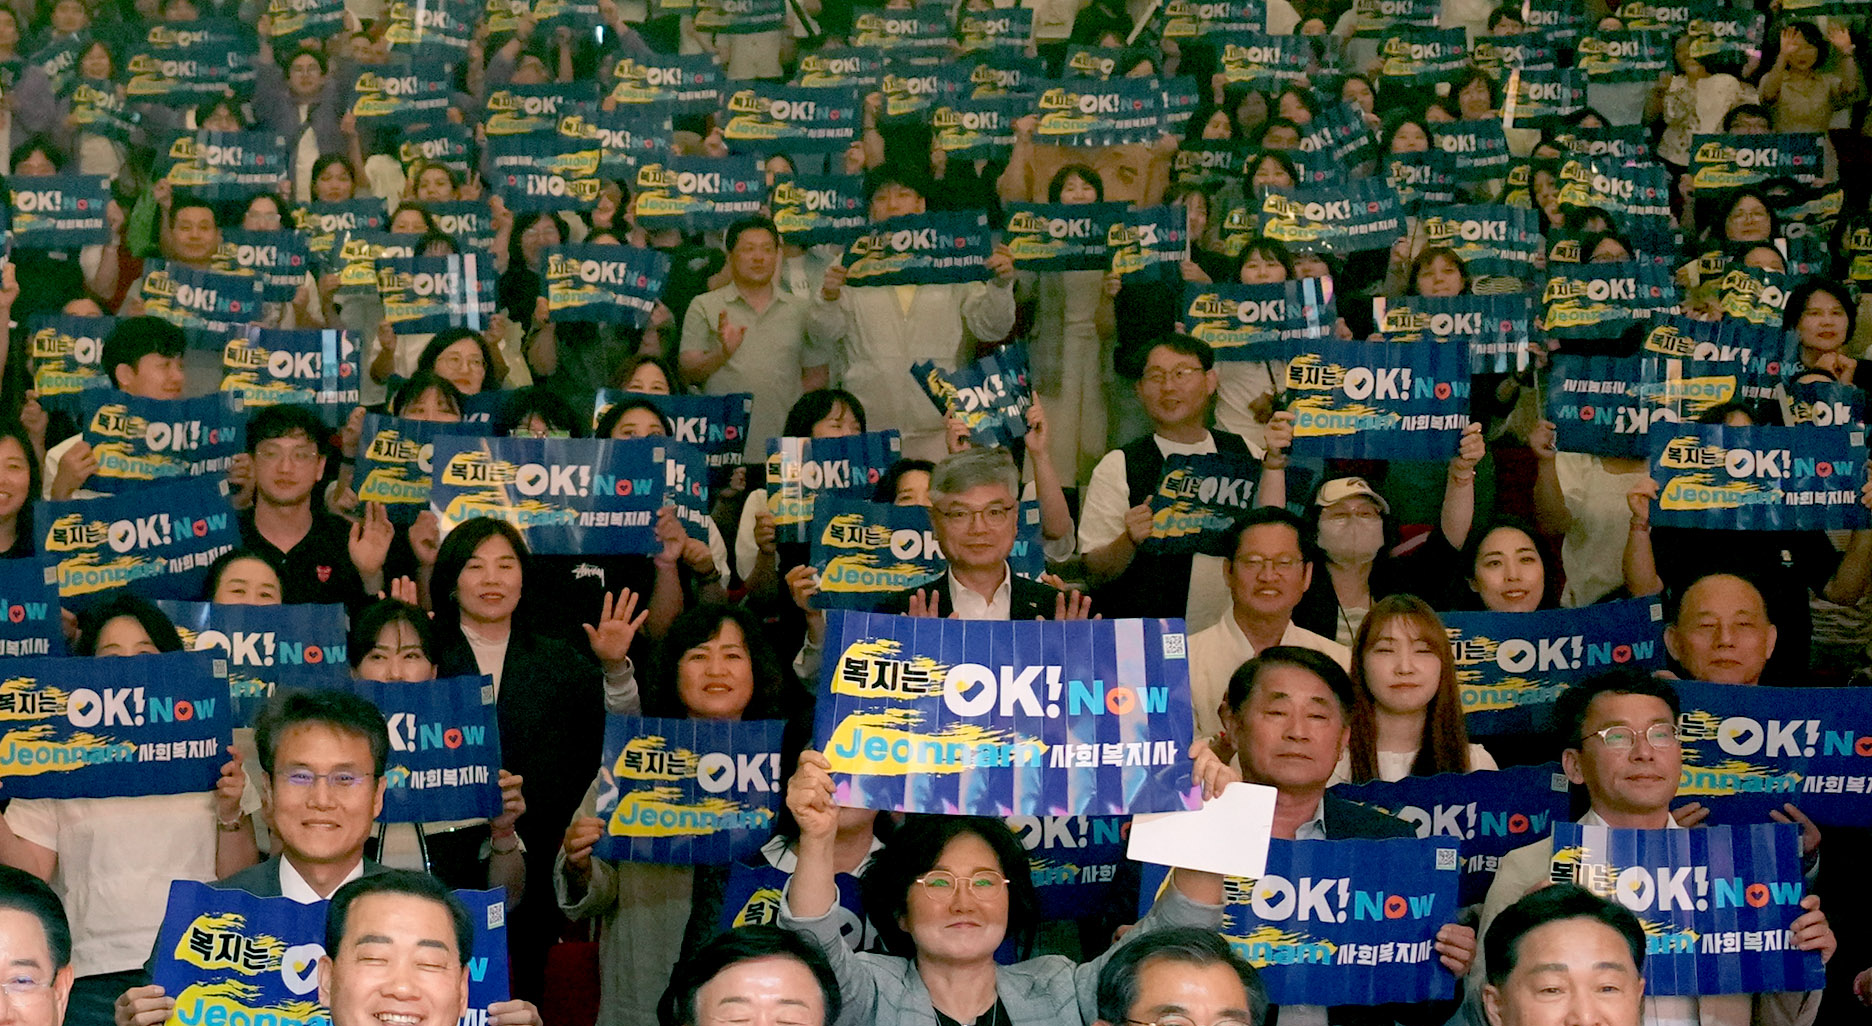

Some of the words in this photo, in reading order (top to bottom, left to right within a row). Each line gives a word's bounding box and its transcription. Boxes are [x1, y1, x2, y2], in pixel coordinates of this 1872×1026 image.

[770, 100, 815, 121] OK!
[1735, 148, 1777, 168] OK!
[1304, 199, 1350, 220] OK!
[1343, 367, 1410, 400] OK!
[515, 463, 590, 497] OK!
[1725, 447, 1790, 478] OK!
[108, 513, 171, 553] OK!
[1496, 635, 1583, 673] OK!
[842, 657, 929, 694] 복지는
[944, 664, 1063, 718] OK!
[67, 688, 146, 728] OK!
[0, 741, 136, 766] Jeonnam
[138, 738, 218, 763] 사회복지사
[835, 728, 1041, 769] Jeonnam
[1049, 739, 1178, 769] 사회복지사
[1717, 717, 1821, 757] OK!
[1823, 731, 1872, 757] No
[410, 767, 489, 788] 사회복지사
[624, 751, 687, 776] 복지는
[697, 752, 781, 793] OK!
[617, 802, 772, 831] Jeonnam
[1251, 875, 1350, 923] OK!
[1616, 866, 1709, 911] OK!
[190, 927, 270, 970] 복지는
[1337, 939, 1432, 966] 사회복지사
